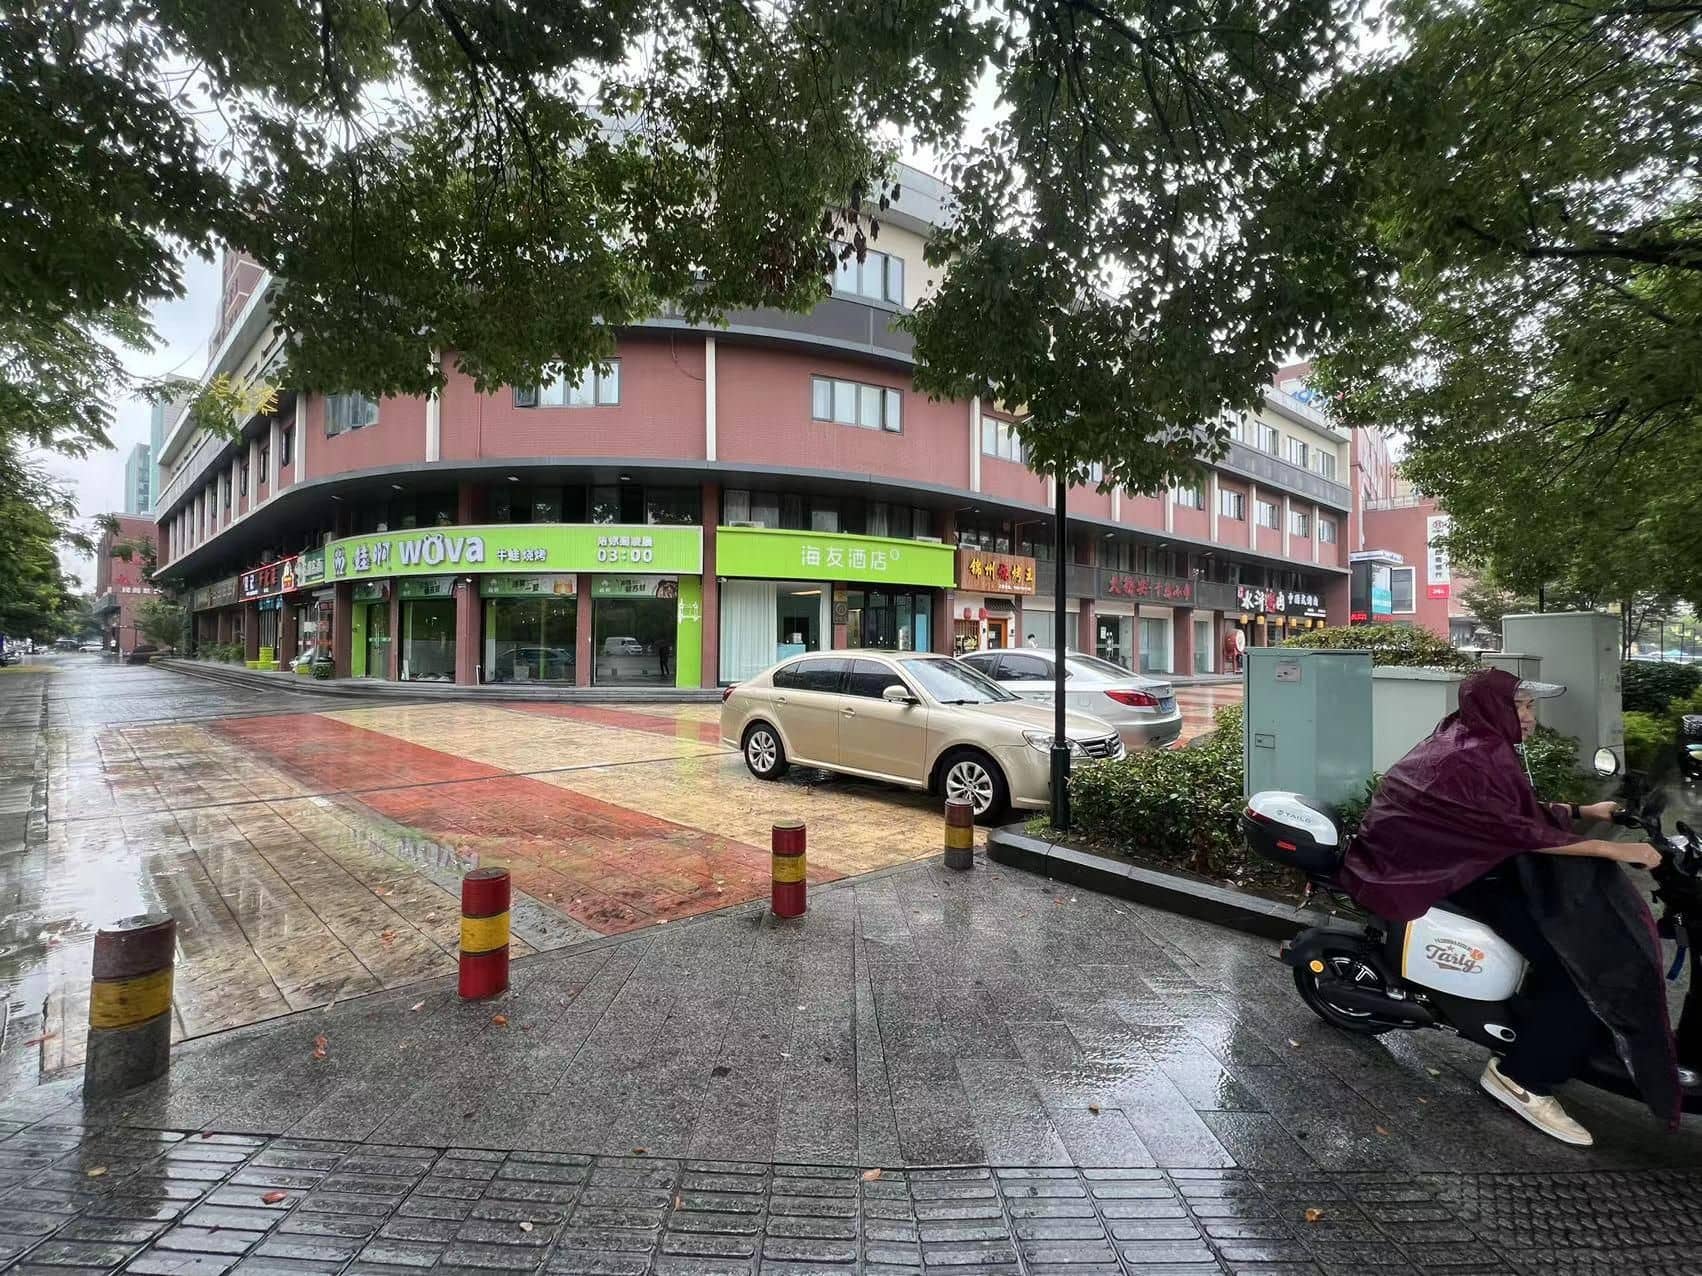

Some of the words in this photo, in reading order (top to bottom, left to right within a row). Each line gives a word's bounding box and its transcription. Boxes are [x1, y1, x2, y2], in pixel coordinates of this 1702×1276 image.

[598, 549, 653, 563] 03:00
[802, 544, 887, 570] 海友酒店
